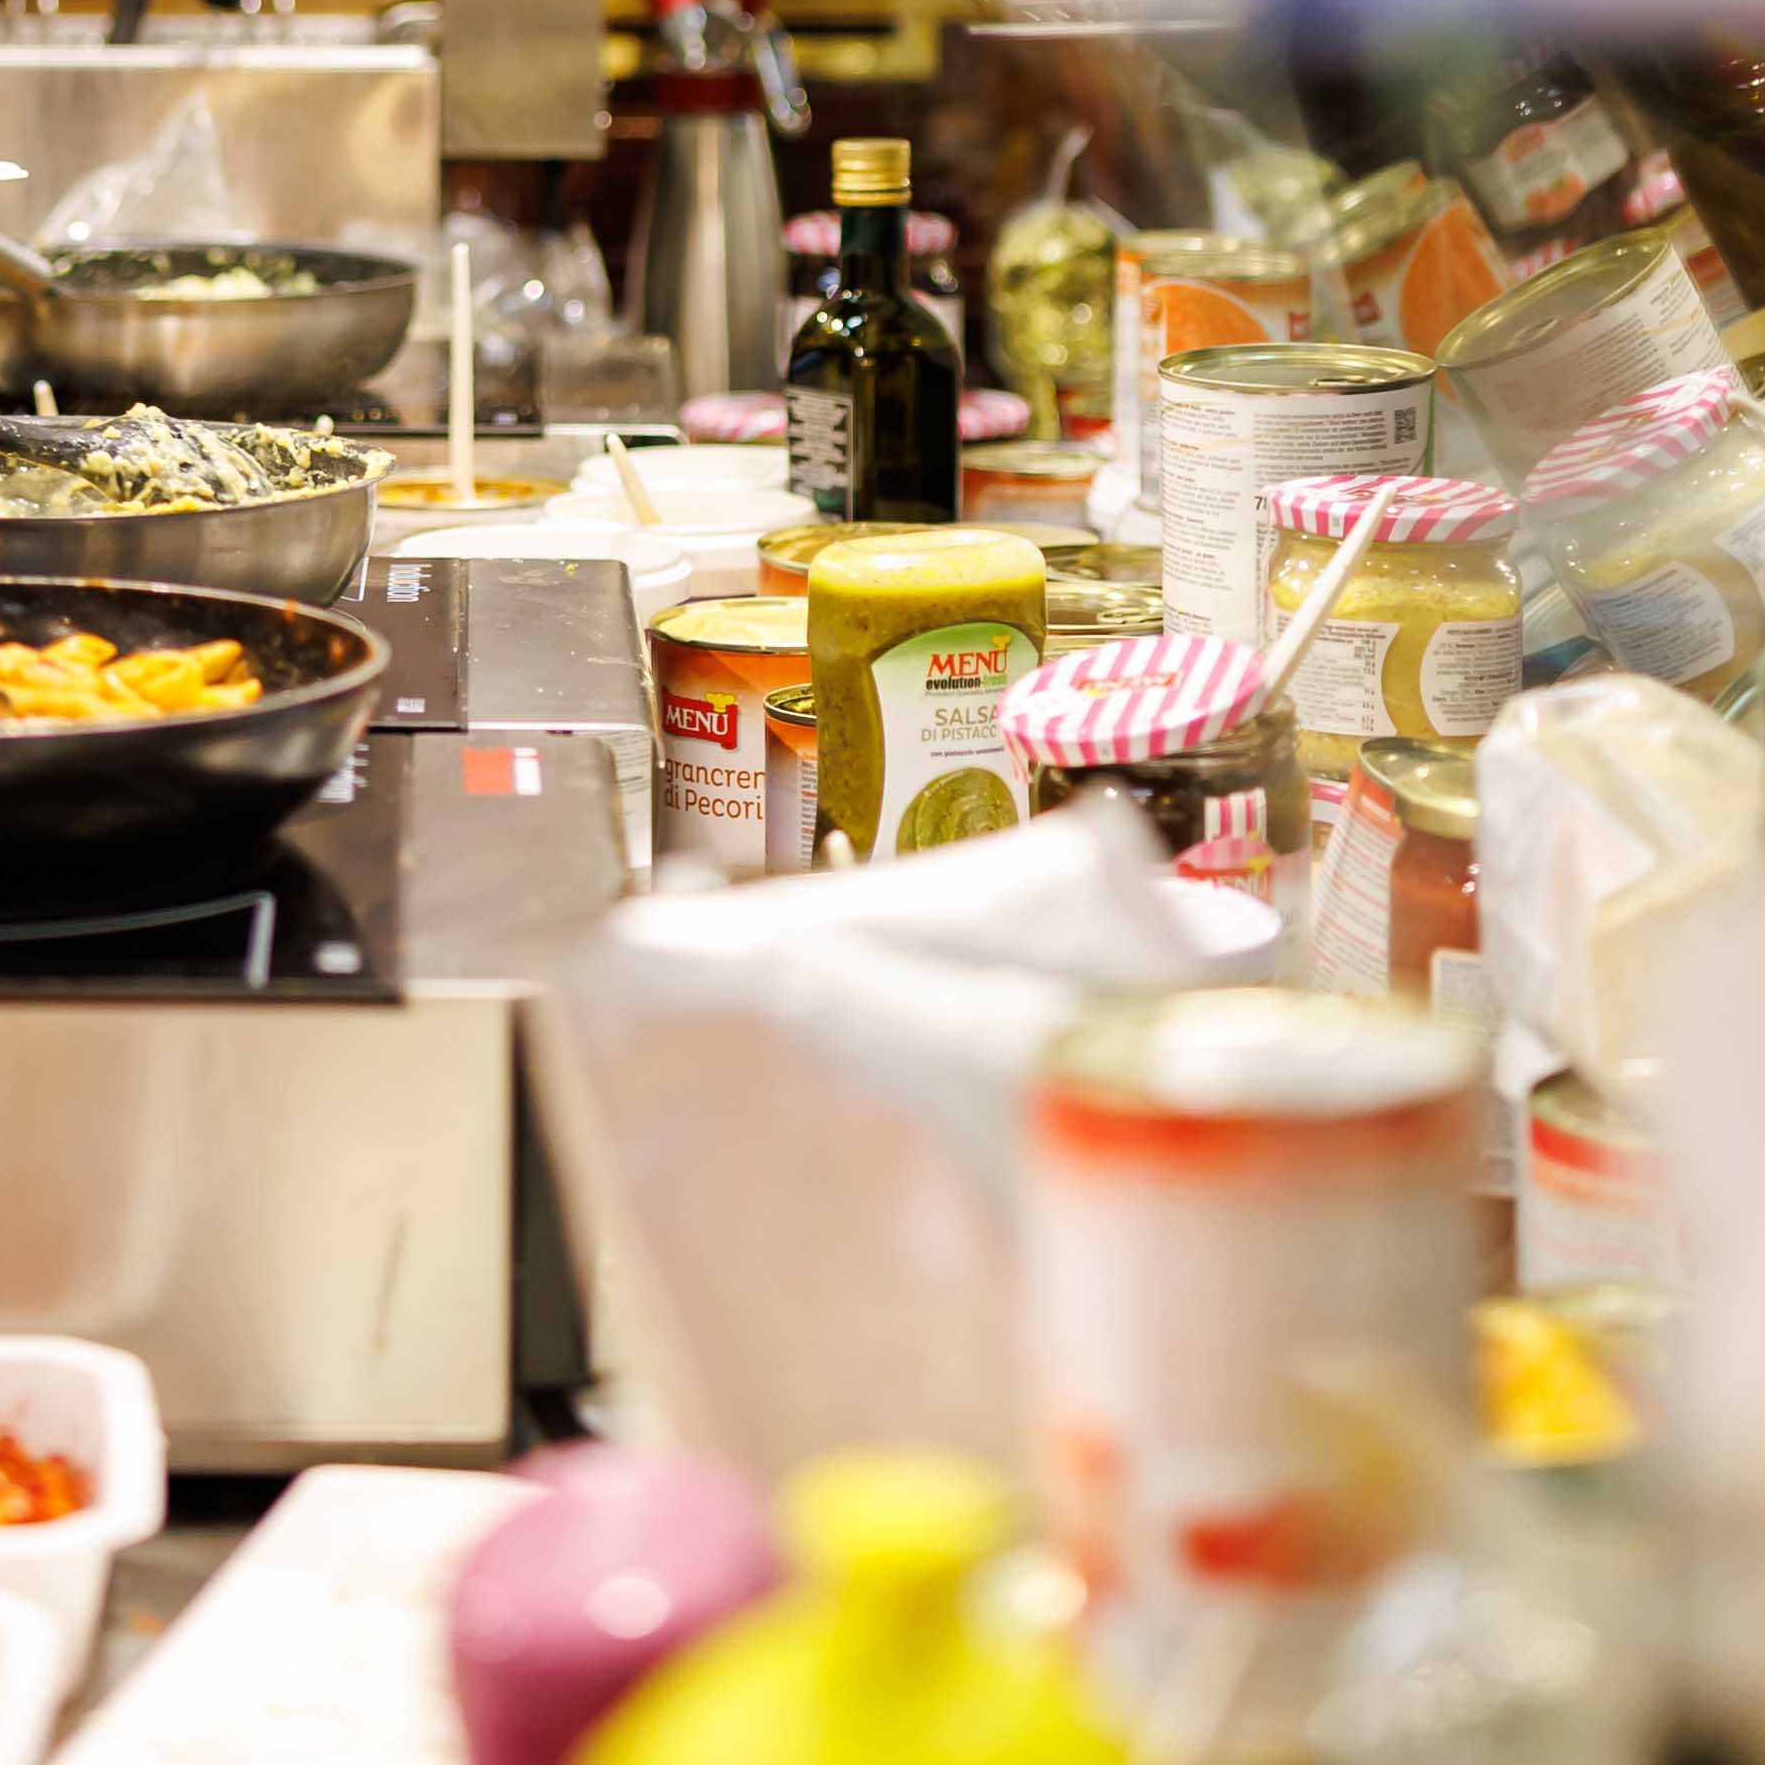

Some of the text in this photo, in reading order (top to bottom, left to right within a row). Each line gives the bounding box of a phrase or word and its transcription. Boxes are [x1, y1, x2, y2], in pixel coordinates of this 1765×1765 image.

[927, 647, 1008, 678] MENU
[666, 705, 729, 736] MENU
[935, 704, 999, 727] SALSA
[921, 728, 938, 743] DI
[665, 788, 764, 821] di Pecori
